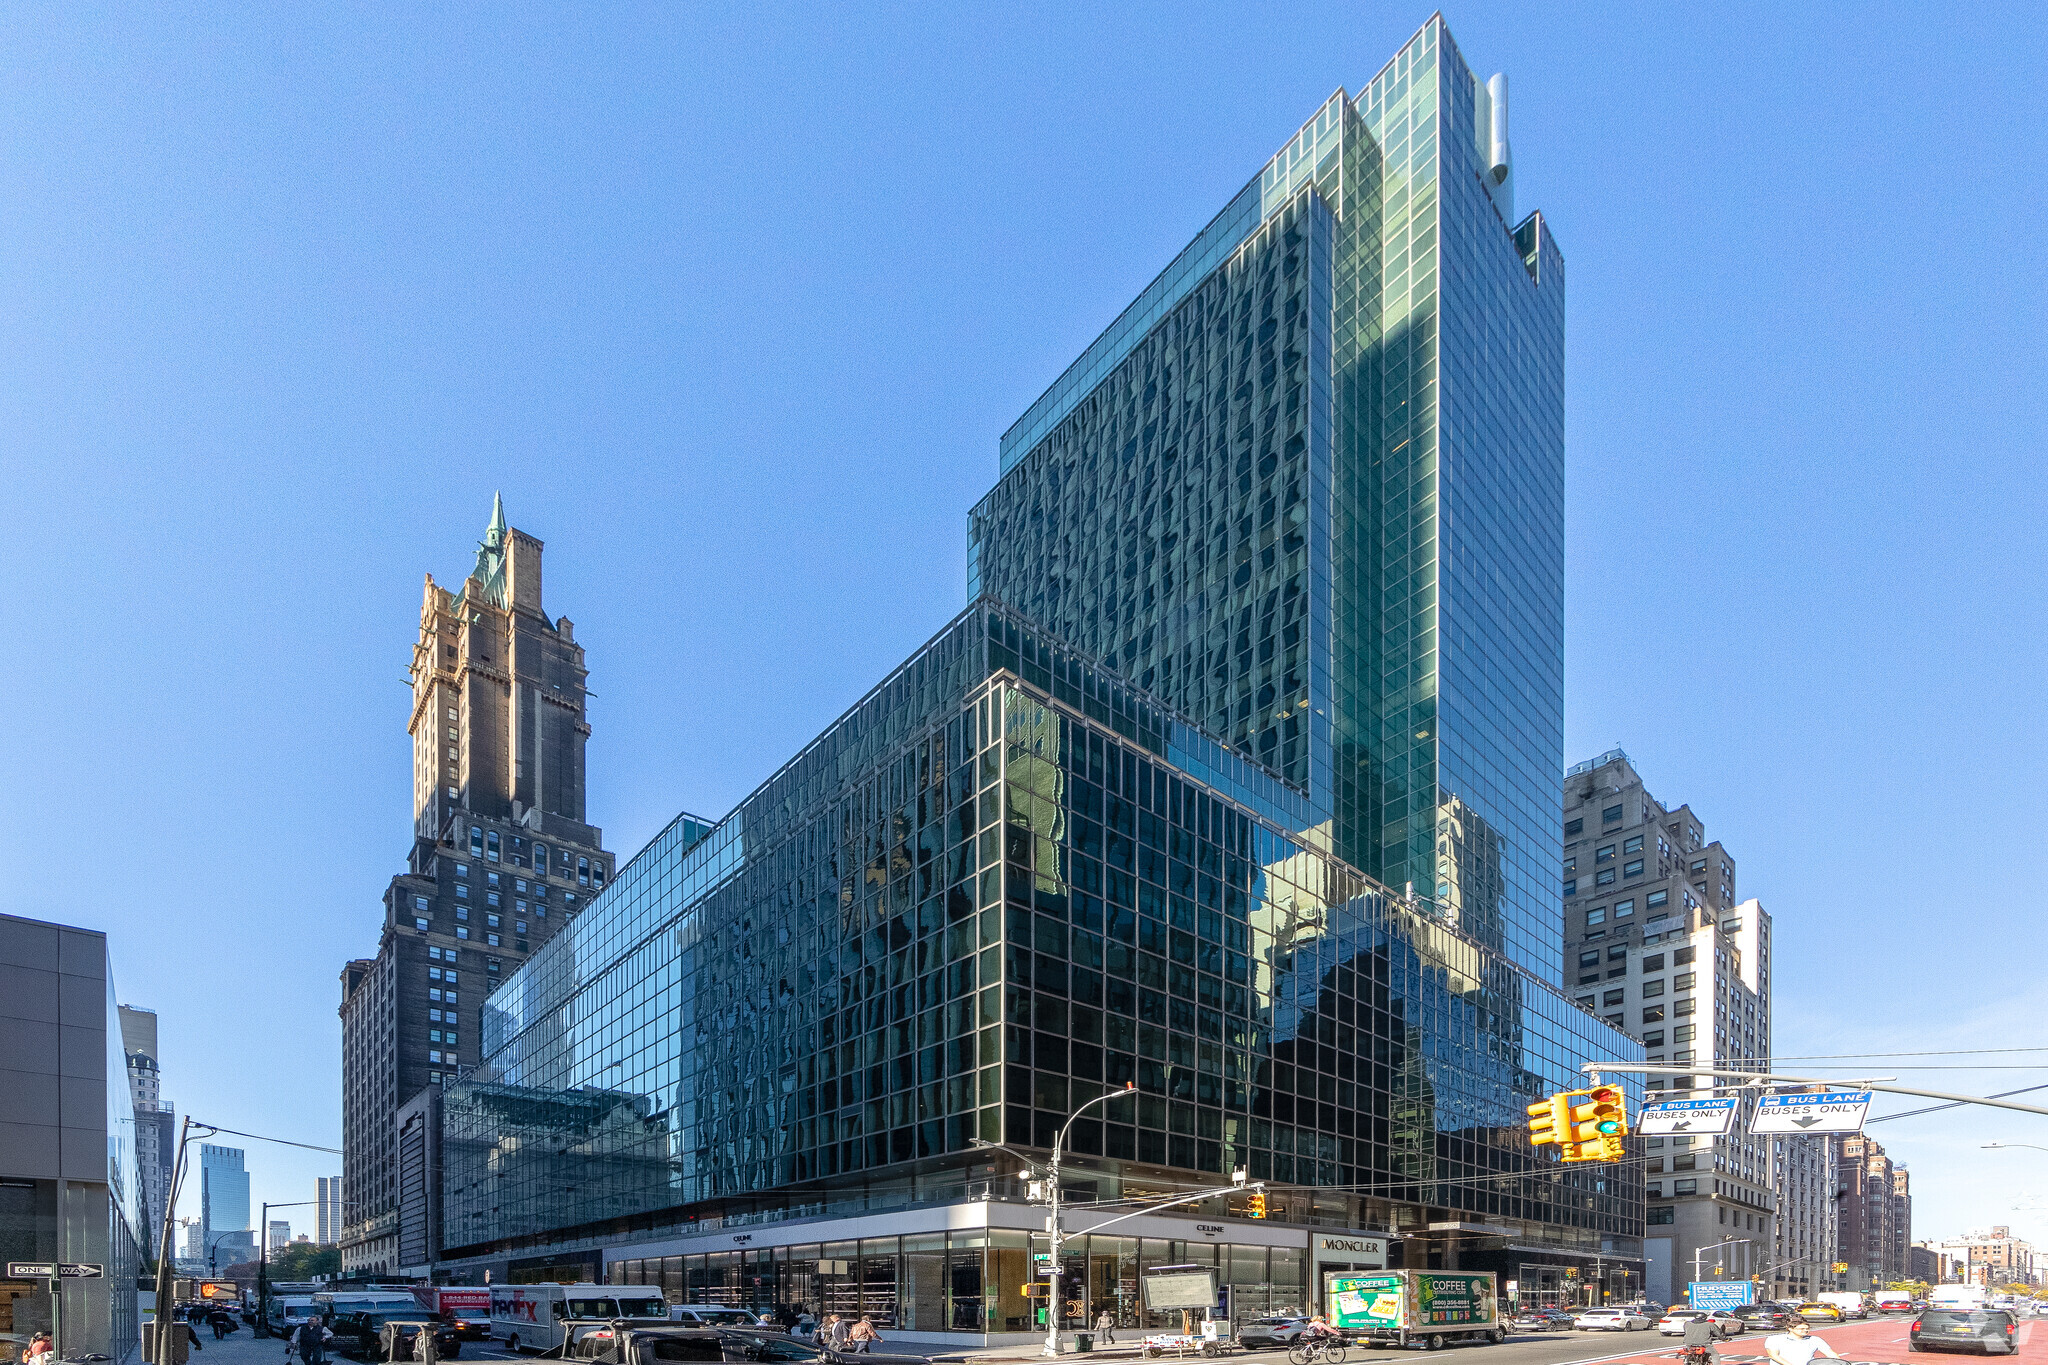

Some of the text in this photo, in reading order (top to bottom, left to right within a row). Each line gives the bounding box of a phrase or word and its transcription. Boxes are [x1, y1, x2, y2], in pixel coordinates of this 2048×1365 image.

[1787, 1094, 1866, 1104] BUS LANE
[1666, 1100, 1729, 1110] BUS LANE
[1760, 1104, 1863, 1115] BUSES ONLY
[1646, 1109, 1726, 1120] BUSES ONLY
[1196, 1224, 1225, 1233] CELINE
[733, 1234, 752, 1242] CELINE
[1322, 1239, 1379, 1253] MONCLER
[1355, 1280, 1390, 1289] COFFEE
[1432, 1280, 1467, 1291] COFFEE
